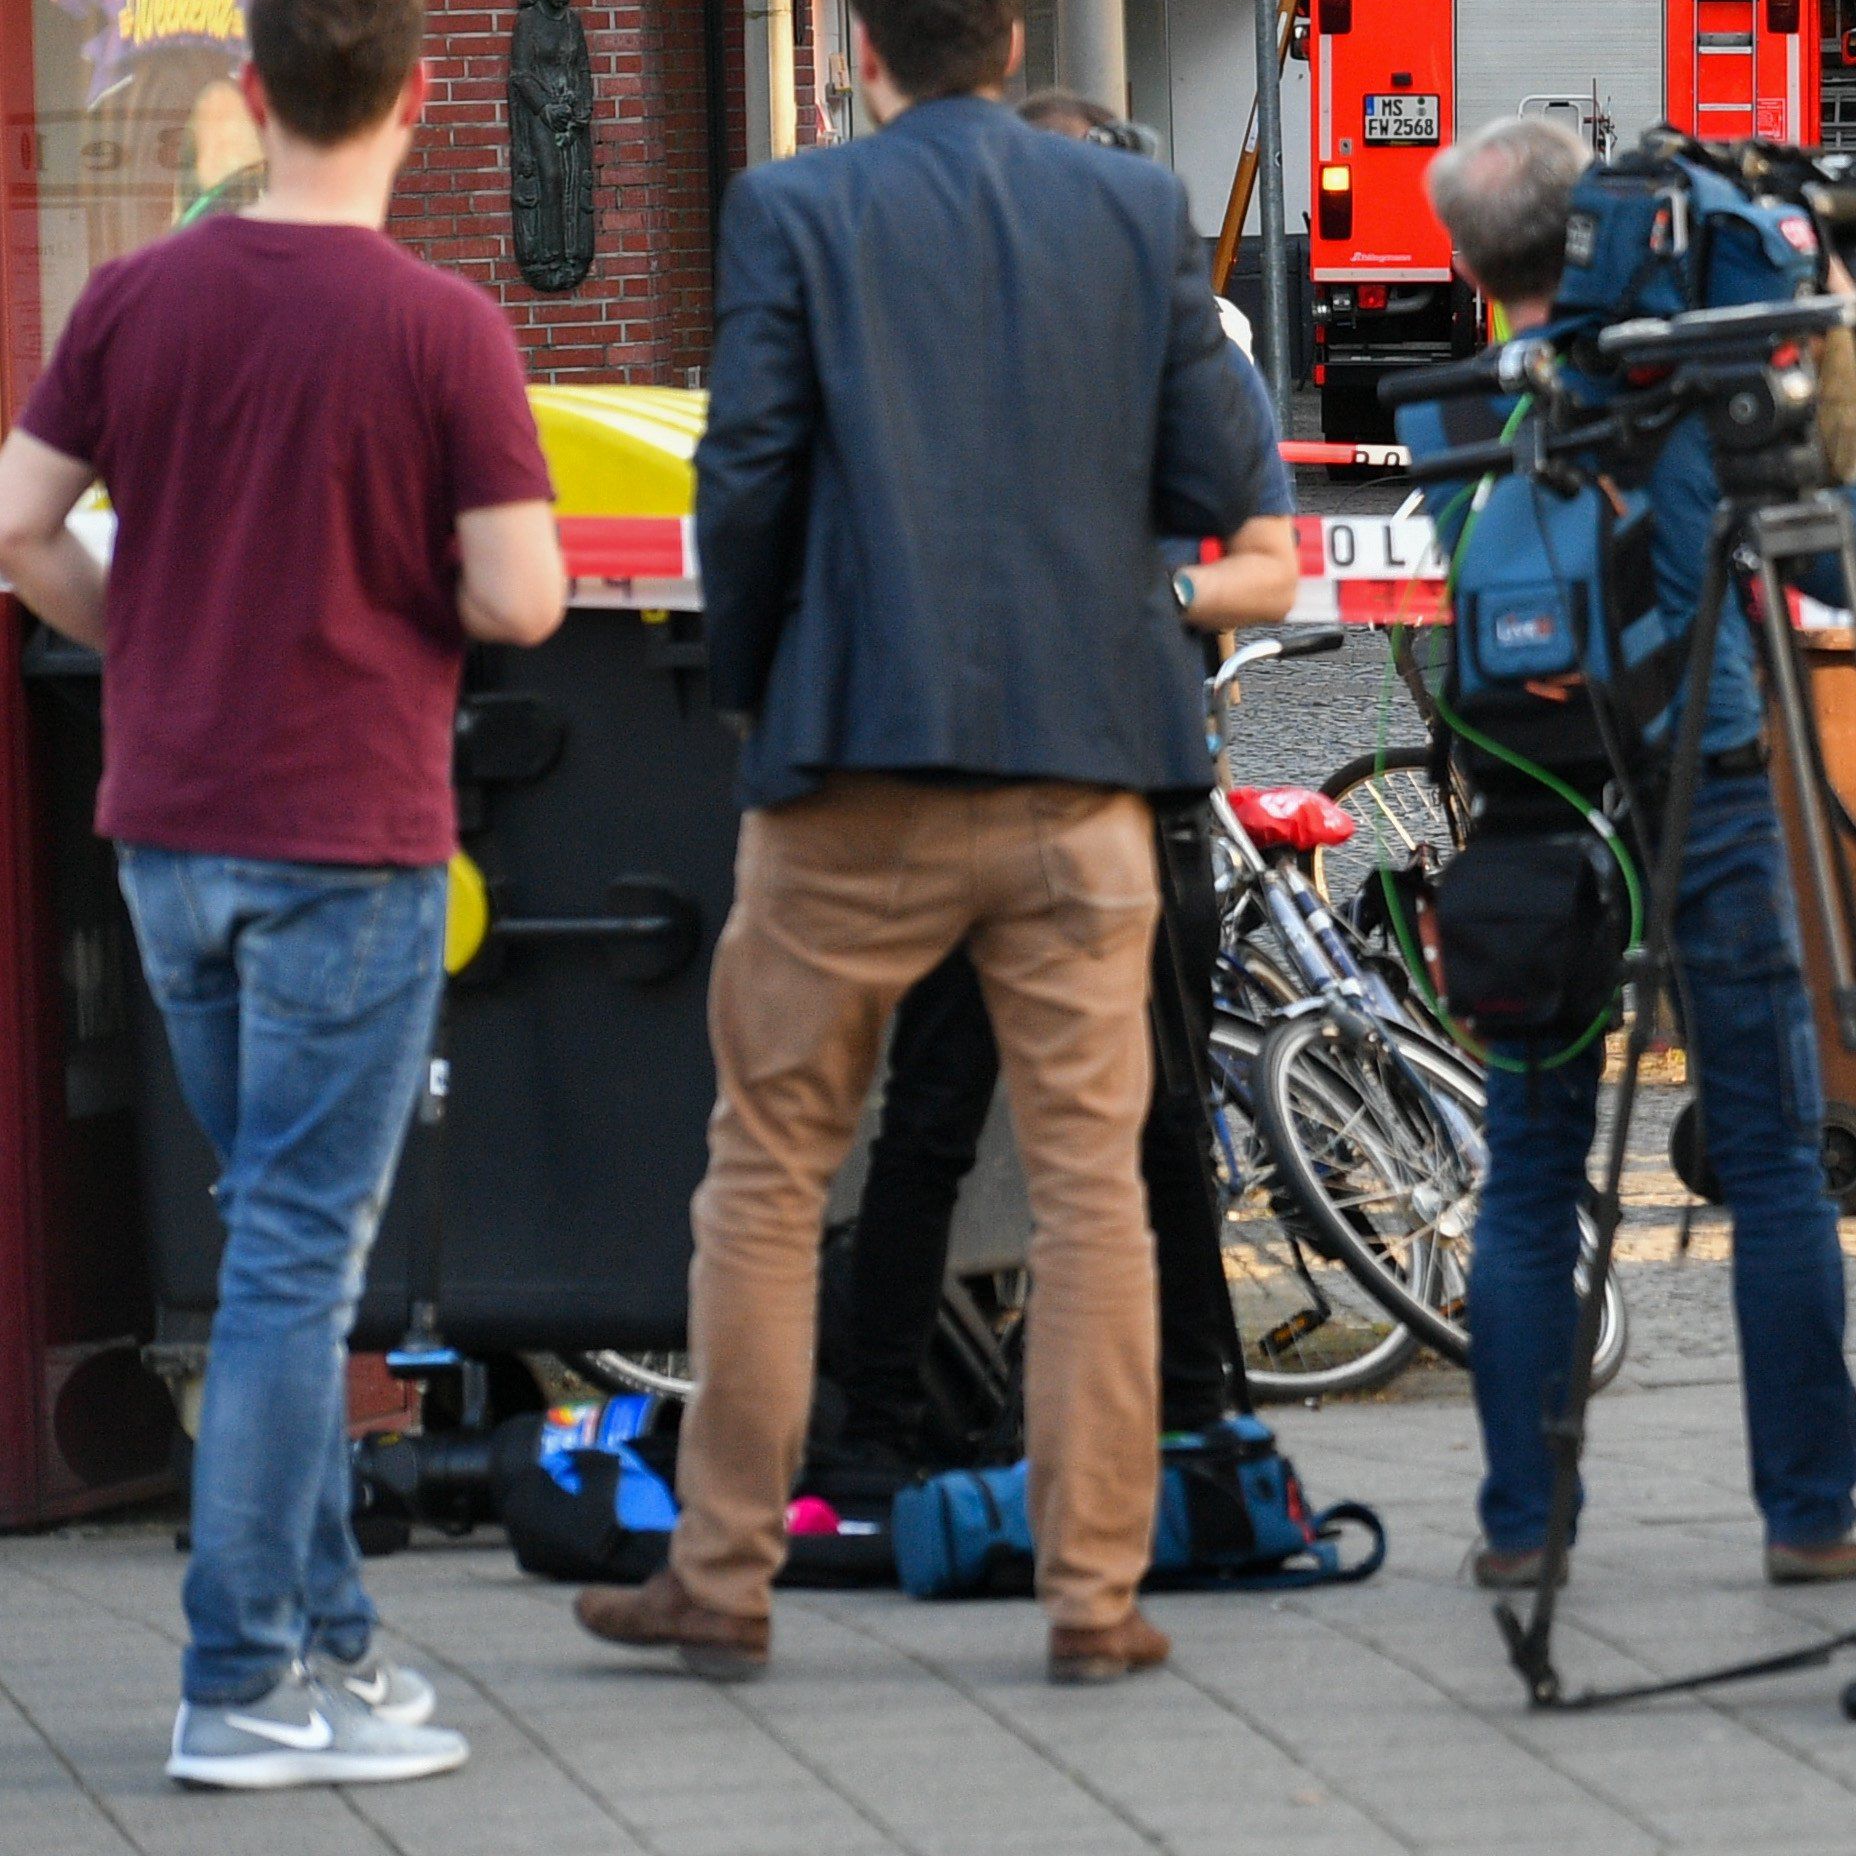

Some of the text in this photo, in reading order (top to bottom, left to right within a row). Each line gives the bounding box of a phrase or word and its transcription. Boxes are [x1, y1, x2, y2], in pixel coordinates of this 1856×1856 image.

[1382, 99, 1403, 117] MS
[1368, 118, 1434, 136] FW 2568
